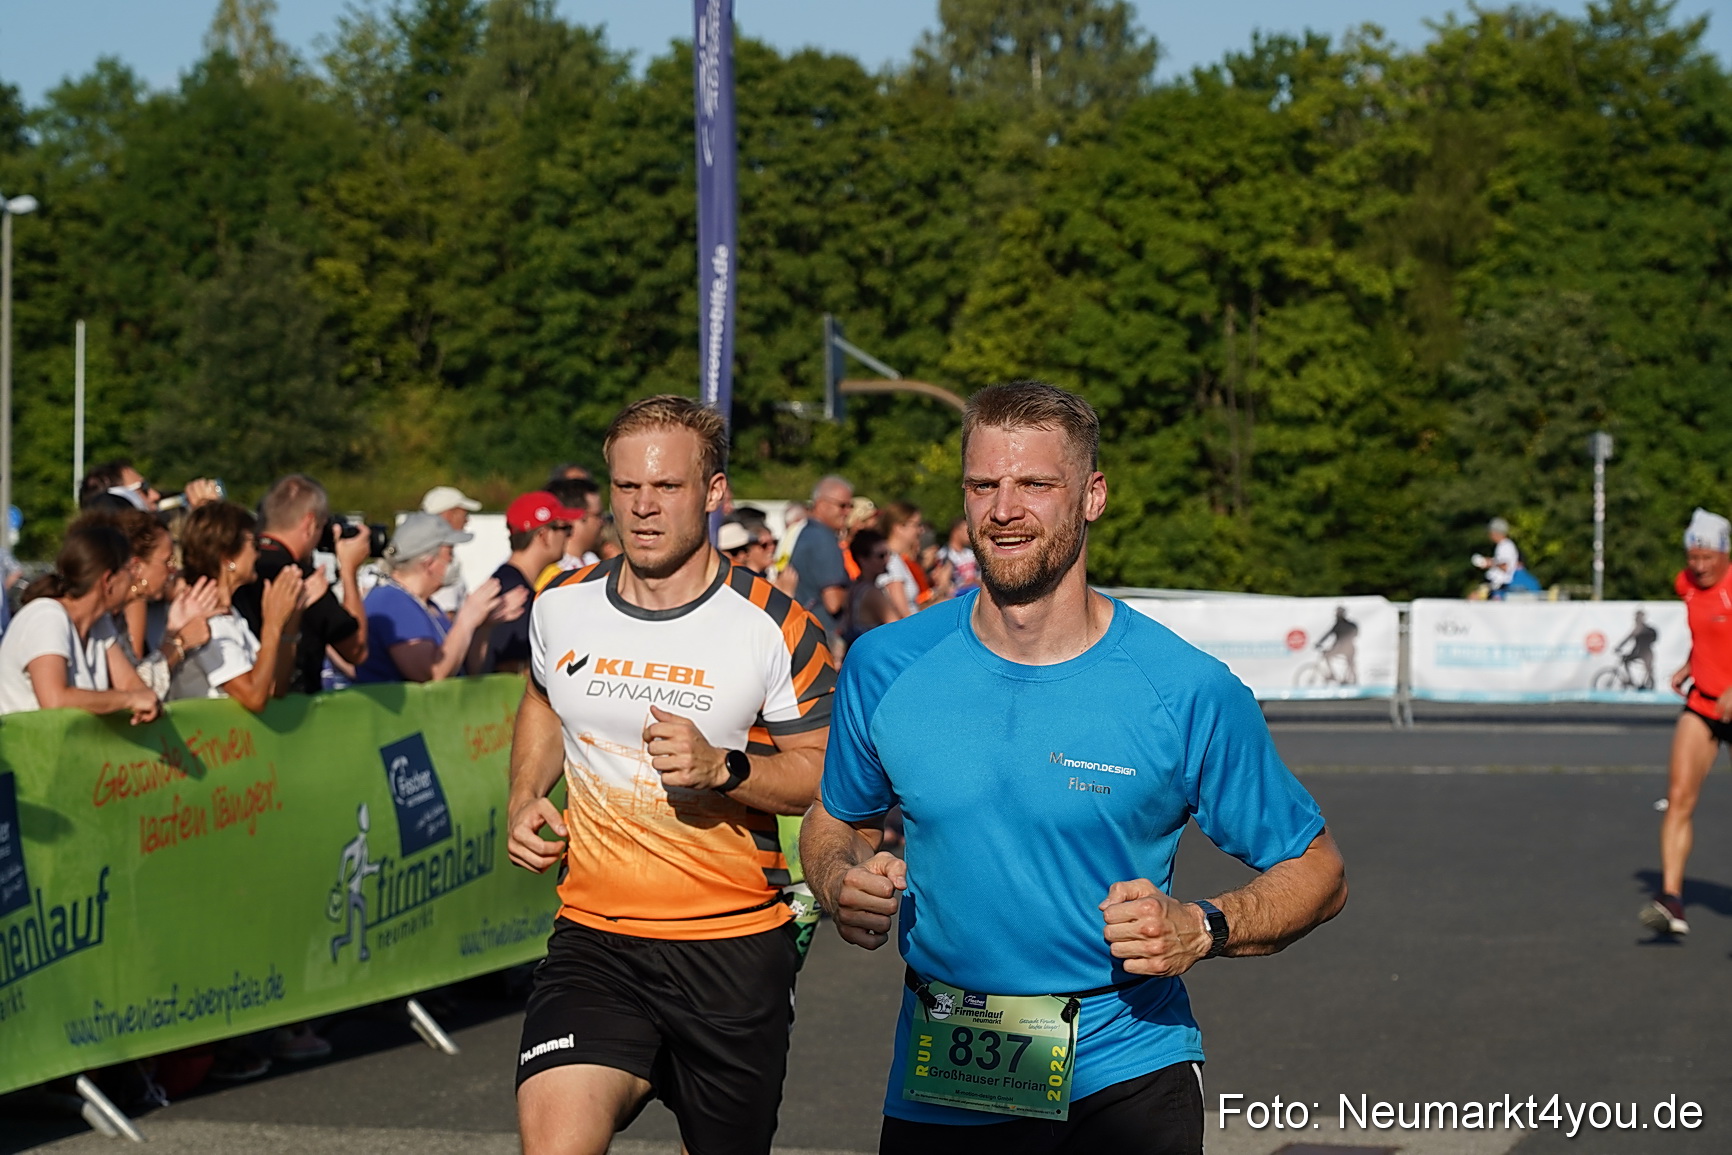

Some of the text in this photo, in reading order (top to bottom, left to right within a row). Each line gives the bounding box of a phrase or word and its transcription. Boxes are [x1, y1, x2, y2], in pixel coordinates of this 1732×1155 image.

[594, 658, 715, 689] KLEBL
[586, 680, 713, 712] DYNAMICS
[1068, 777, 1111, 795] Florian
[376, 807, 497, 924] firmenlauf
[955, 1007, 1004, 1019] Firmenlauf
[972, 1017, 1002, 1025] neumarkt
[520, 1033, 575, 1066] hummel
[915, 1034, 933, 1077] RUN
[949, 1027, 1033, 1074] 837
[929, 1066, 1047, 1093] Großhauser Florian
[1047, 1046, 1067, 1102] 2022
[955, 1089, 997, 1101] M-motion-design
[997, 1094, 1014, 1102] GmbH
